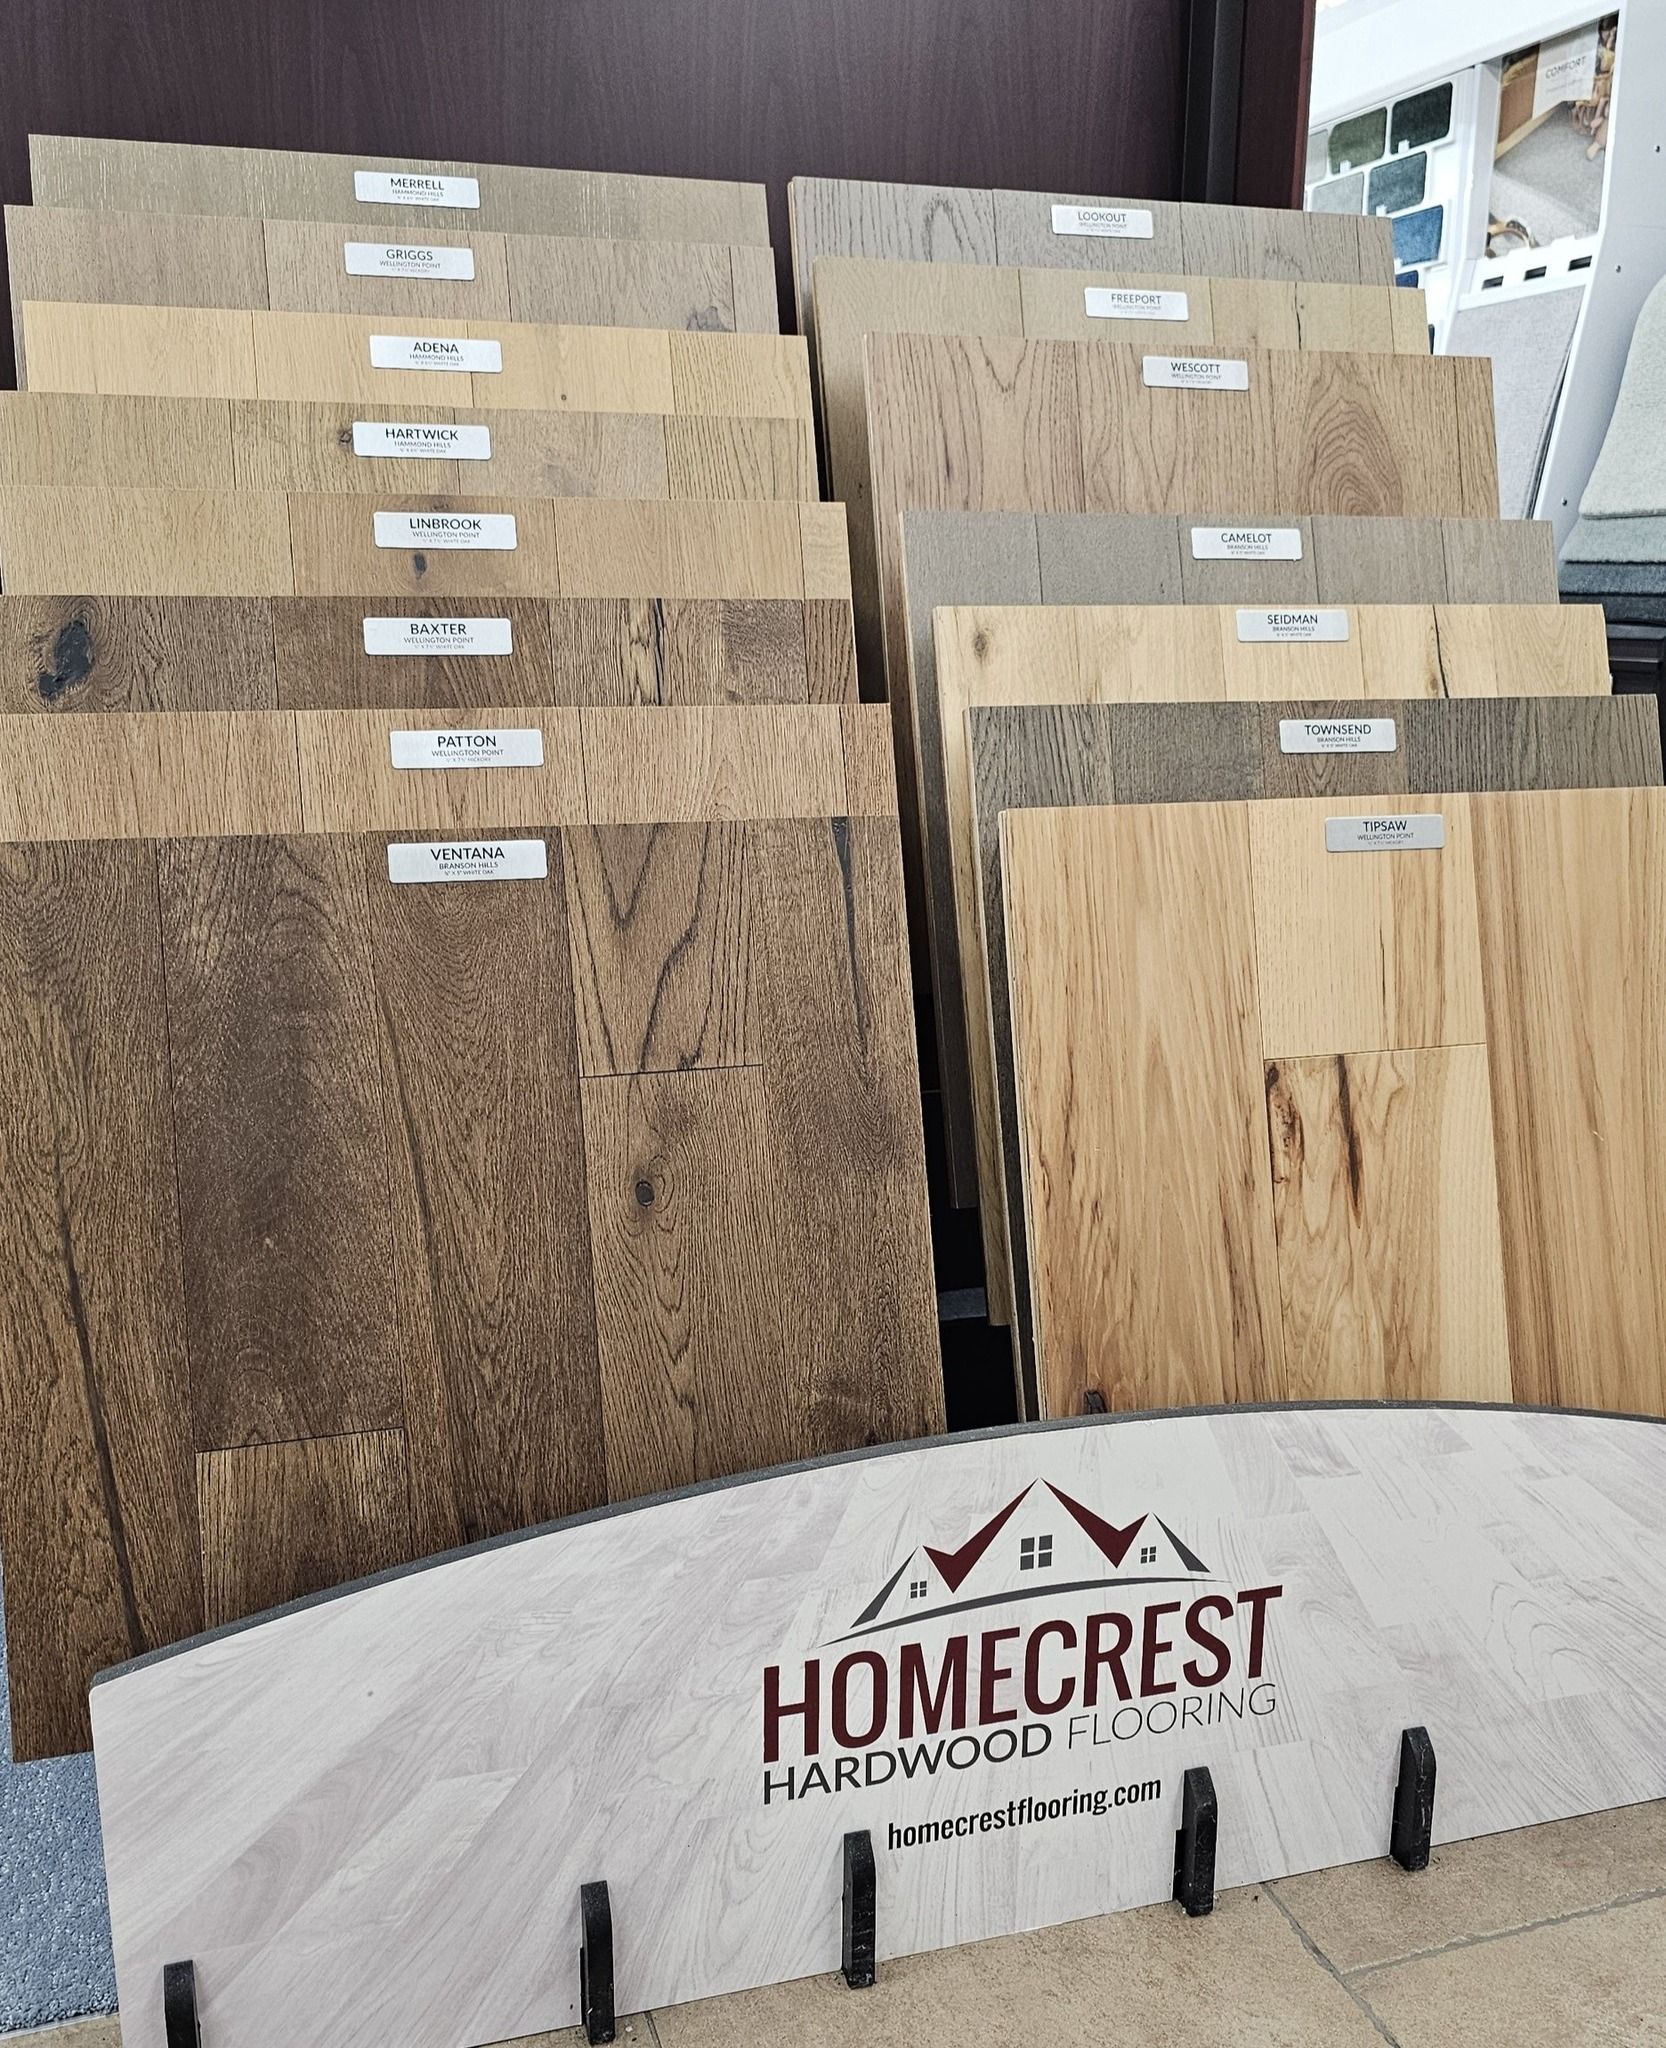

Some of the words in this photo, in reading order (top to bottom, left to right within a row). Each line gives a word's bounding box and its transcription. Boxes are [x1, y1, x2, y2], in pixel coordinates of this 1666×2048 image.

[1545, 55, 1587, 80] COMFORT
[390, 177, 444, 191] MERRELL
[1077, 211, 1127, 223] LOOKOUT
[386, 248, 433, 261] GRIGGS
[1111, 293, 1161, 305] FREEPORT
[413, 342, 459, 354] ADENA
[1170, 362, 1221, 374] WESCOTT
[385, 428, 459, 441] HARTWICK
[409, 518, 482, 530] LINBROOK
[1221, 533, 1272, 543] CAMELOT
[1267, 614, 1319, 625] SEIDMAN
[410, 623, 467, 636] BAXTER
[403, 636, 451, 644] WELLINGTON
[1304, 724, 1372, 736] TOWNSEND
[437, 735, 497, 748] PATTON
[431, 749, 480, 757] WELLINGTON
[1363, 820, 1407, 833] TIPSAW
[430, 847, 506, 861] VENTANA
[438, 862, 477, 870] BRANSON
[762, 1585, 1283, 1764] HOMECREST
[763, 1722, 1052, 1805] HARDWOOD
[1067, 1682, 1277, 1751] FLOORING
[887, 1779, 1162, 1850] homecrestflooring.com
